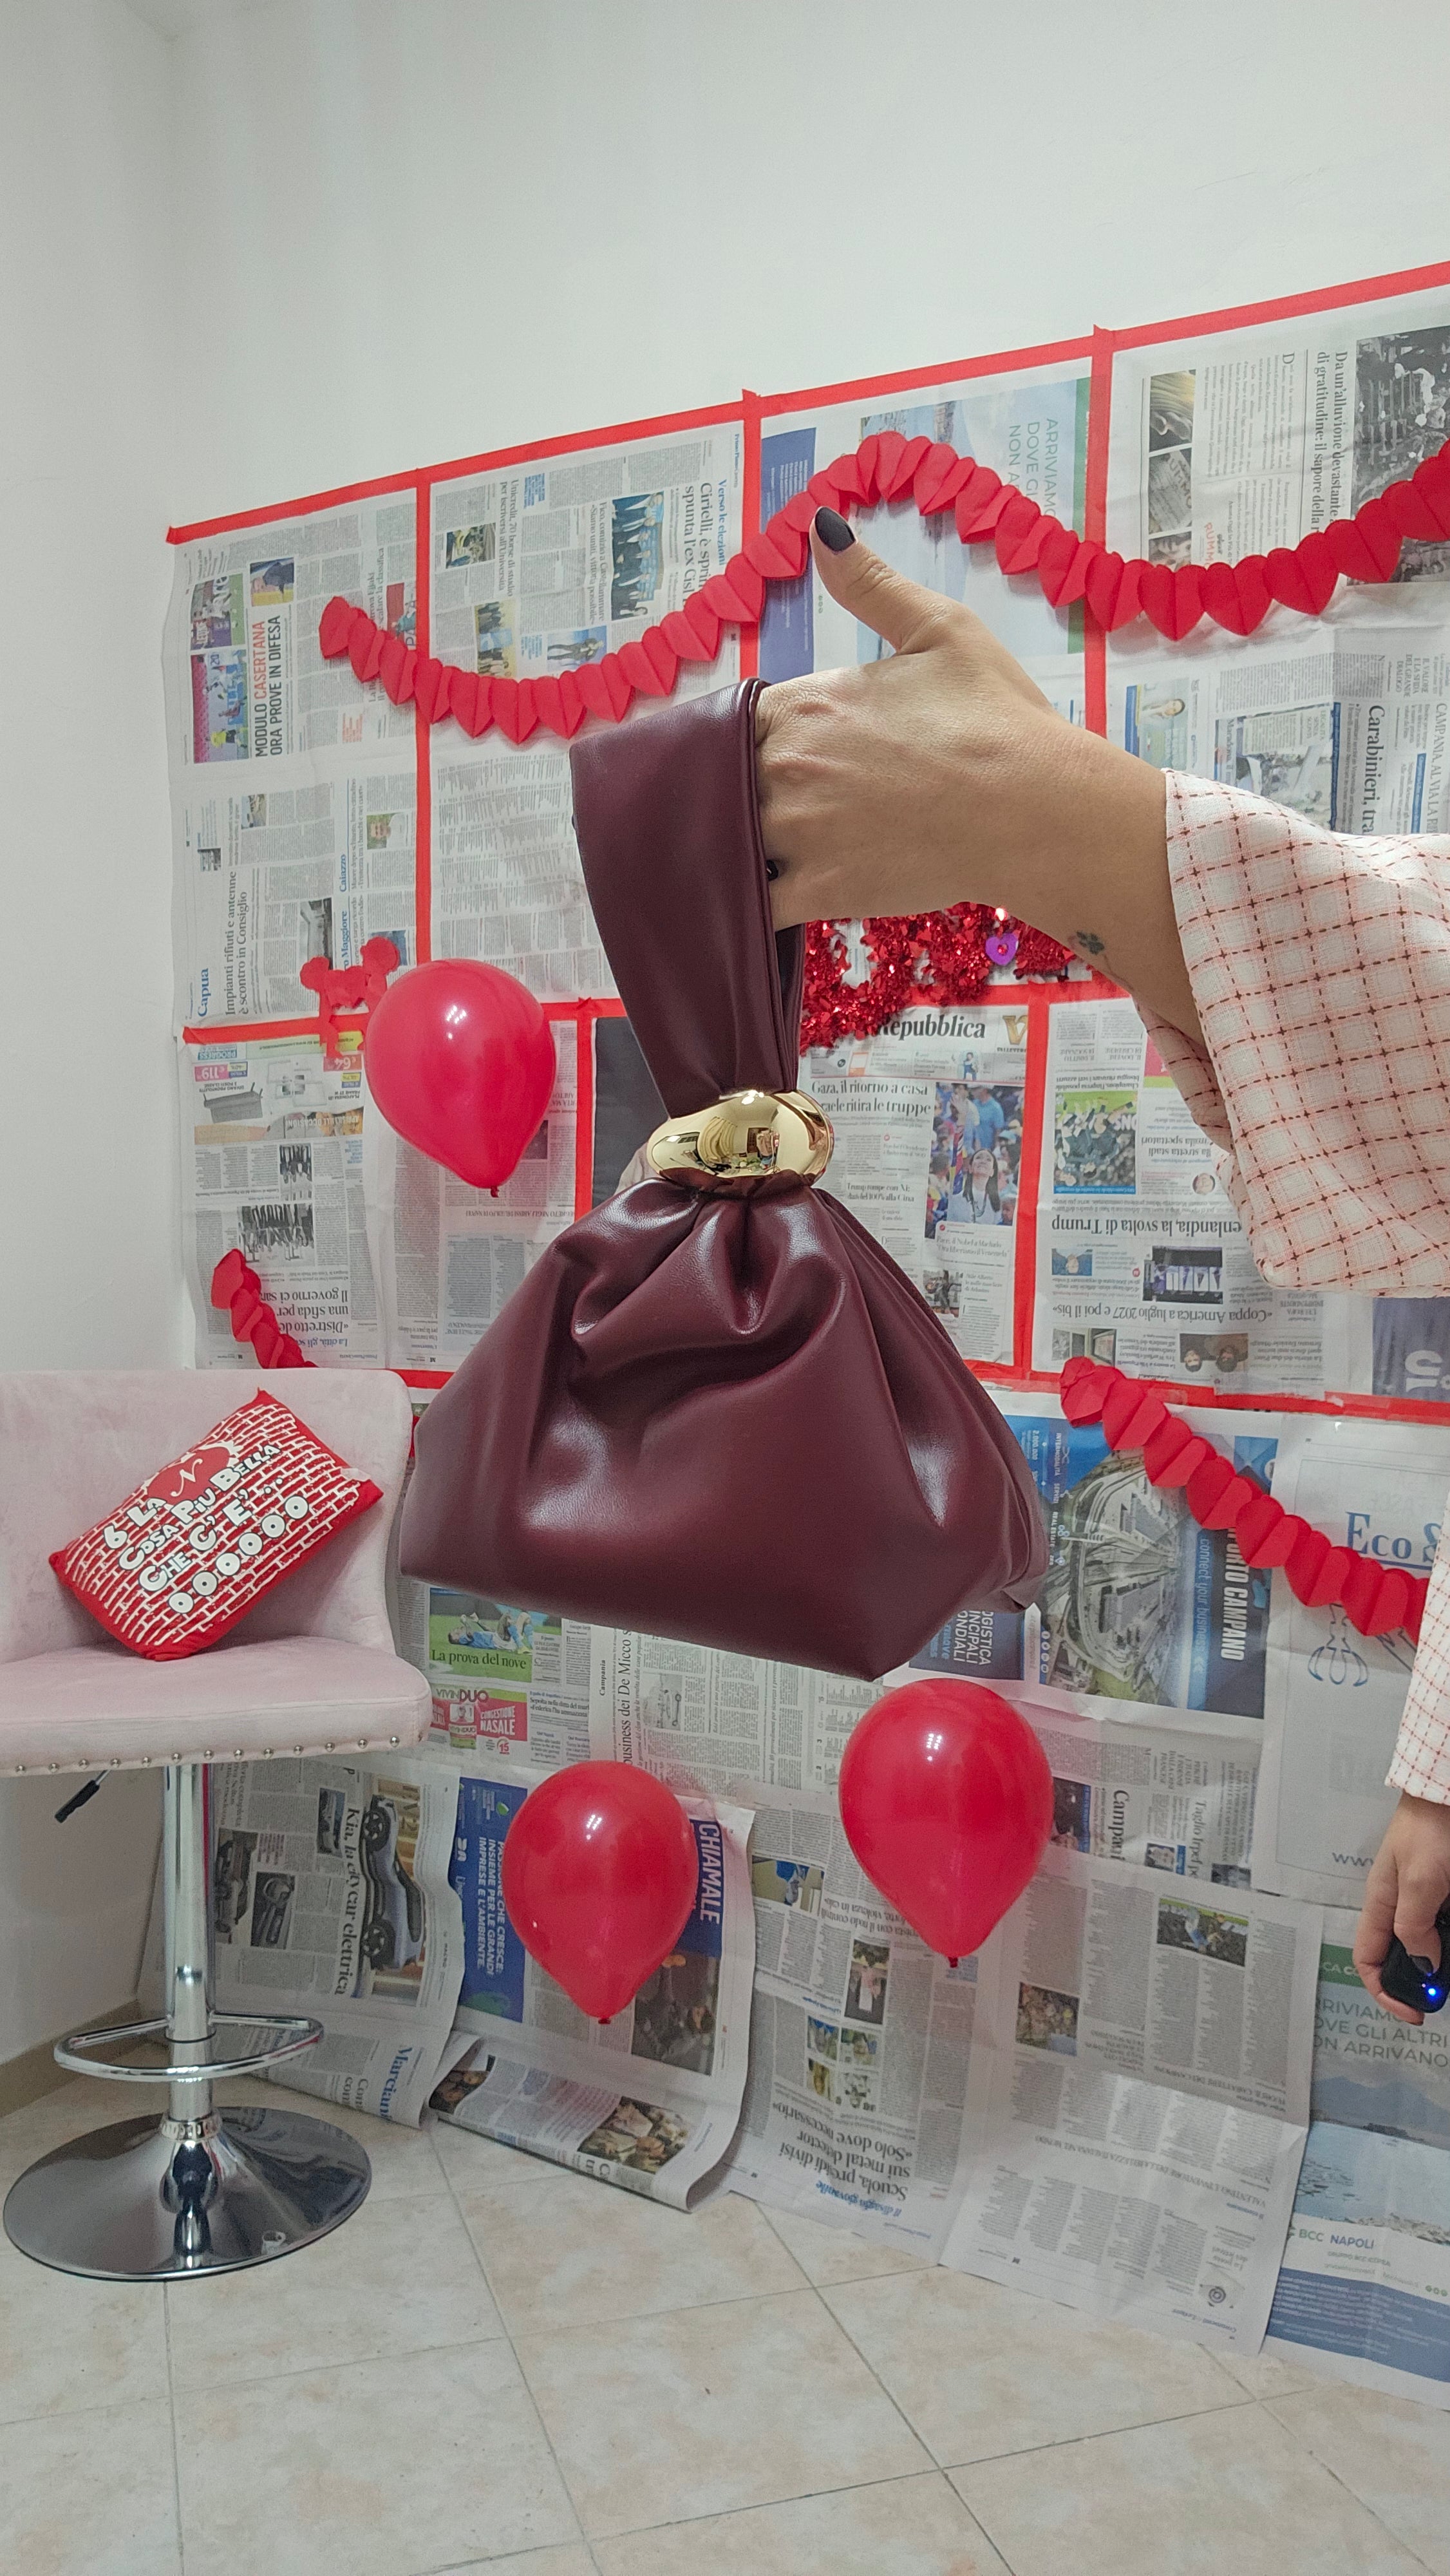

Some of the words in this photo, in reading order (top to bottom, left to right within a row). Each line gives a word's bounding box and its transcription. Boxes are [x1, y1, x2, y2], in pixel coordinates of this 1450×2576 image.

[1317, 352, 1329, 363] di
[1335, 352, 1347, 370] Da
[1314, 367, 1328, 440] gratitudine:
[1333, 373, 1347, 449] un'alluvione
[1009, 425, 1021, 466] NON
[1026, 422, 1040, 473] DOVE
[1311, 454, 1324, 493] sapore
[1330, 451, 1344, 516] devastante
[500, 482, 508, 494] per
[718, 479, 727, 511] Verso
[509, 480, 518, 521] Unicredit,
[683, 486, 695, 536] spunta
[699, 482, 713, 535] Cirielli,
[1311, 495, 1324, 524] della
[499, 497, 507, 534] iscriversi
[718, 514, 727, 523] le
[509, 524, 517, 533] 70
[508, 535, 516, 556] borse
[684, 540, 695, 566] l'ex
[717, 525, 727, 566] elezioni
[499, 536, 507, 591] all'Università
[508, 560, 516, 569] di
[683, 569, 695, 593] Cisl
[267, 616, 281, 661] DIFESA
[252, 621, 267, 699] CASERTANA
[268, 665, 281, 678] IN
[269, 683, 282, 724] PROVE
[254, 703, 267, 757] MODULO
[270, 728, 283, 755] ORA
[1432, 703, 1447, 762] CAMPANIA,
[1362, 705, 1385, 806] Carabinieri,
[227, 871, 236, 918] antenne
[236, 892, 249, 945] Consiglio
[223, 930, 234, 963] rifiuti
[341, 911, 350, 958] Maggiore
[236, 947, 246, 958] in
[197, 967, 211, 1017] Capua
[224, 965, 236, 1015] Impianti
[238, 961, 247, 1005] scontro
[198, 1050, 236, 1059] PROGRESS
[811, 1081, 839, 1095] Gaza,
[840, 1080, 847, 1094] il
[849, 1080, 889, 1094] ritorno
[891, 1084, 898, 1094] a
[901, 1084, 928, 1095] casa
[1106, 1081, 1138, 1090] Champions,
[847, 1099, 872, 1113] ritira
[874, 1097, 885, 1113] le
[887, 1100, 931, 1117] truppe
[284, 1118, 322, 1130] OCCASIONI
[1141, 1135, 1183, 1146] spettatori
[1149, 1148, 1169, 1157] stadi
[1171, 1148, 1198, 1157] stretta
[1052, 1214, 1102, 1235] Trump
[1105, 1218, 1118, 1235] di
[1121, 1219, 1158, 1236] svolta
[1162, 1220, 1172, 1236] la
[280, 1292, 290, 1303] ci
[292, 1287, 339, 1302] governo
[341, 1290, 348, 1303] Il
[276, 1304, 294, 1316] per
[297, 1306, 326, 1319] sfida
[328, 1305, 348, 1315] una
[1053, 1304, 1071, 1318] bis»
[1075, 1305, 1082, 1319] il
[1084, 1303, 1101, 1318] poi
[1104, 1306, 1110, 1316] e
[1114, 1307, 1137, 1320] 2027
[1139, 1305, 1165, 1321] luglio
[1177, 1307, 1225, 1322] America
[1229, 1305, 1272, 1321] «Coppa
[294, 1321, 348, 1333] «Distretto
[308, 1338, 317, 1347] gli
[319, 1338, 337, 1347] città,
[102, 1526, 129, 1550] 6
[1345, 1511, 1411, 1560] Eco
[1199, 1539, 1210, 1579] connect
[1194, 1584, 1209, 1604] your
[953, 1610, 967, 1661] ONDIALI
[1221, 1587, 1248, 1660] CAMPANO
[966, 1610, 980, 1663] INCIPALI
[978, 1610, 993, 1665] OGISTICA
[432, 1649, 446, 1661] La
[449, 1653, 480, 1665] prova
[482, 1653, 499, 1665] del
[502, 1657, 527, 1669] nove
[617, 1640, 631, 1675] Micco
[599, 1660, 607, 1696] Campania
[618, 1678, 630, 1695] De
[617, 1700, 630, 1716] dei
[480, 1719, 516, 1736] NASALE
[619, 1720, 632, 1763] business
[343, 1808, 360, 1841] Kia,
[1192, 1802, 1207, 1835] Taglio
[344, 1845, 357, 1860] la
[478, 1837, 487, 1886] IMPRESE
[1189, 1839, 1203, 1865] Irpef
[700, 1824, 720, 1925] CHIAMALE
[487, 1889, 496, 1911] PER
[852, 1904, 882, 1920] violenza
[487, 1913, 495, 1926] LE
[335, 1923, 357, 1995] elettrica
[487, 1929, 495, 1975] GRANDI
[1356, 2023, 1386, 2040] GLI
[1393, 2028, 1447, 2048] ALTRI
[1344, 2040, 1447, 2067] ARRIVANO
[773, 2102, 834, 2140] necessario»
[797, 2131, 842, 2164] detector
[836, 2132, 871, 2152] dove
[875, 2141, 912, 2161] «Solo
[778, 2142, 813, 2168] divisi
[845, 2152, 885, 2175] metal
[814, 2156, 856, 2184] presidi
[888, 2165, 910, 2179] sui
[859, 2175, 909, 2201] Scuola,
[1299, 2229, 1324, 2242] BCC
[1330, 2235, 1374, 2249] NAPOLI
